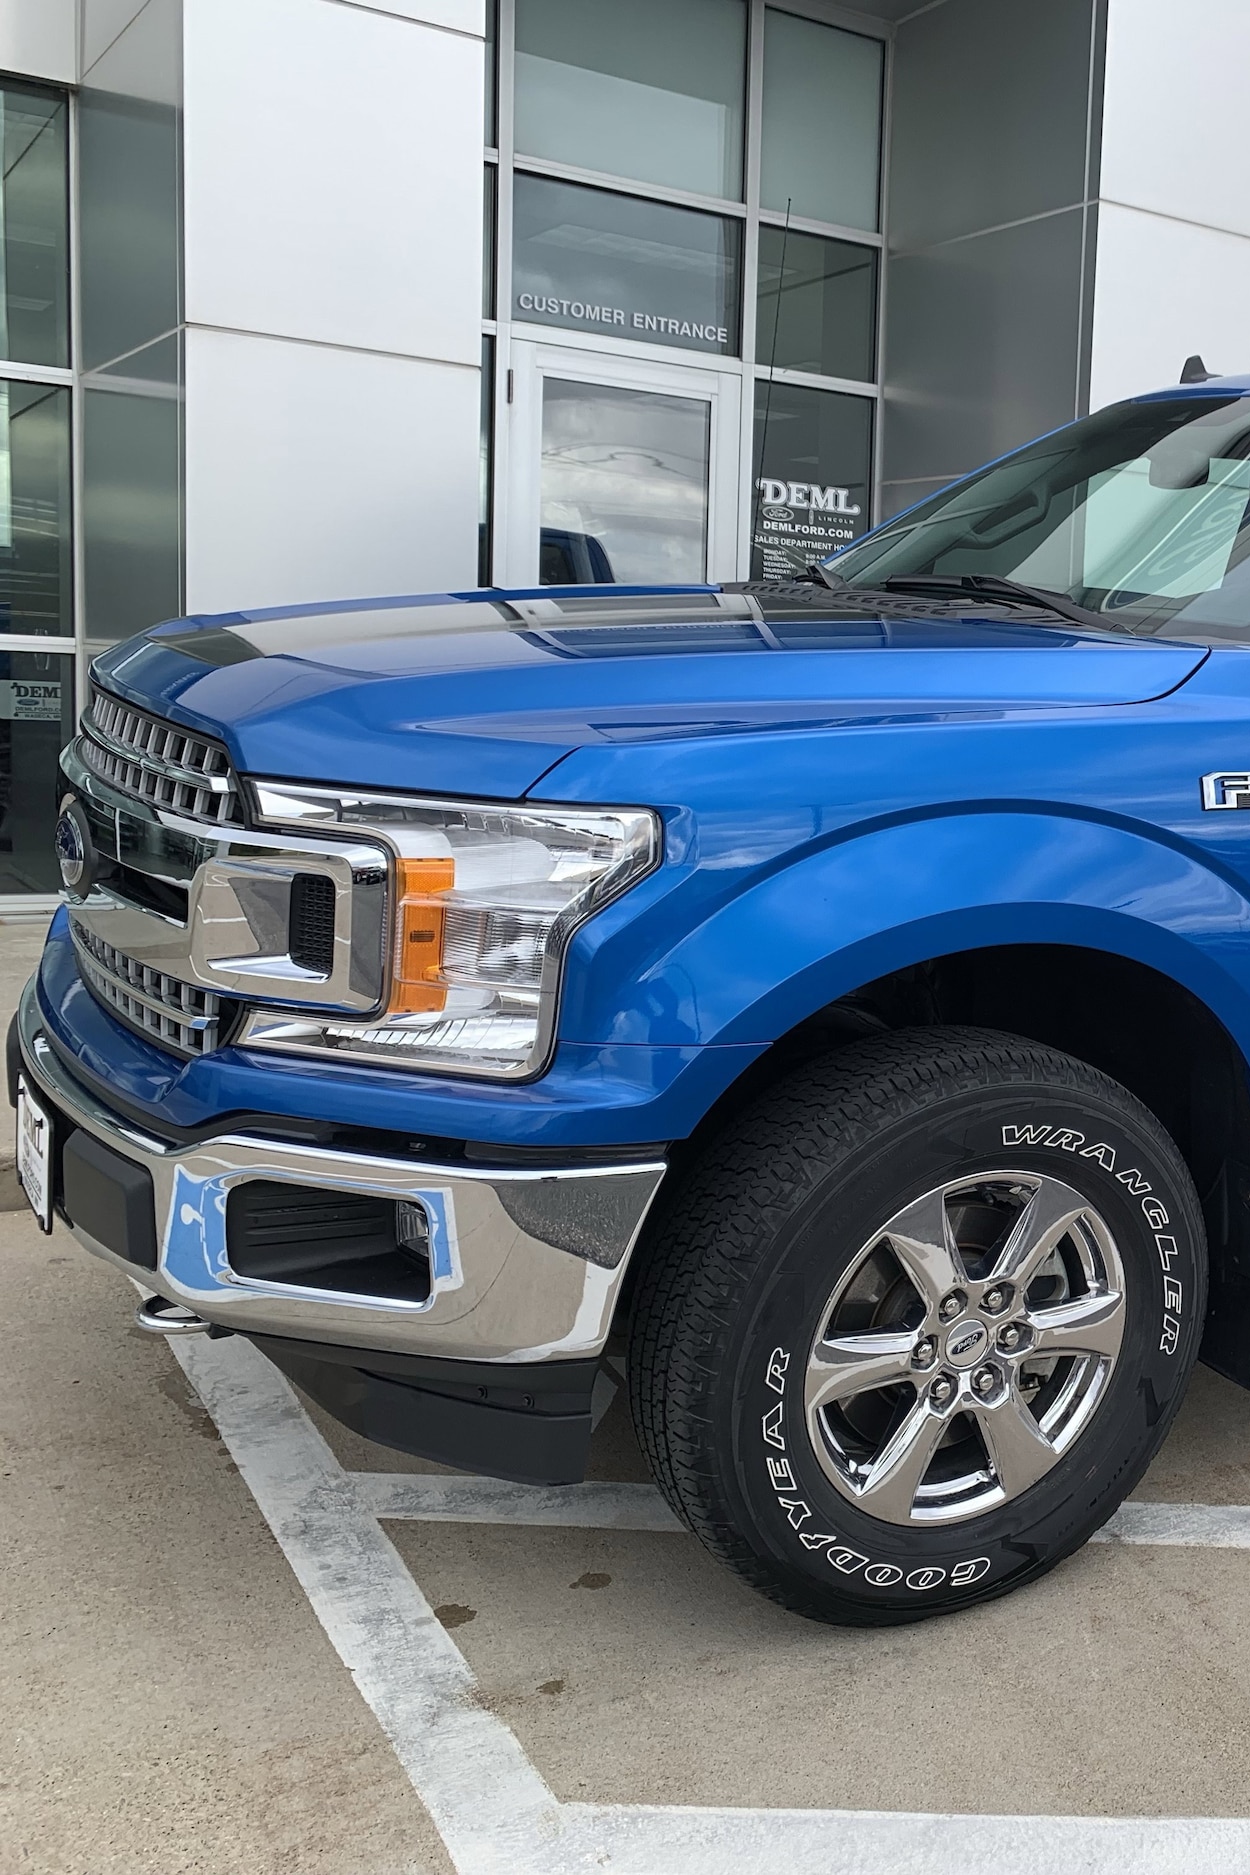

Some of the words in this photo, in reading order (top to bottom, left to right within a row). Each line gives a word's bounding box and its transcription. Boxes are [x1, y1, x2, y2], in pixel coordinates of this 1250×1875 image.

[519, 293, 625, 325] CUSTOMER
[633, 313, 728, 343] ENTRANCE
[755, 478, 860, 515] DEML
[763, 520, 854, 539] DEMLFORD.COM
[818, 515, 854, 525] LINCOLN
[755, 535, 779, 545] SALES
[780, 538, 833, 552] DEPARTMENT
[11, 682, 61, 698] DEM
[1002, 1124, 1183, 1356] WRANGLER
[957, 1333, 979, 1352] Ford
[763, 1346, 991, 1590] GOODYEAR
